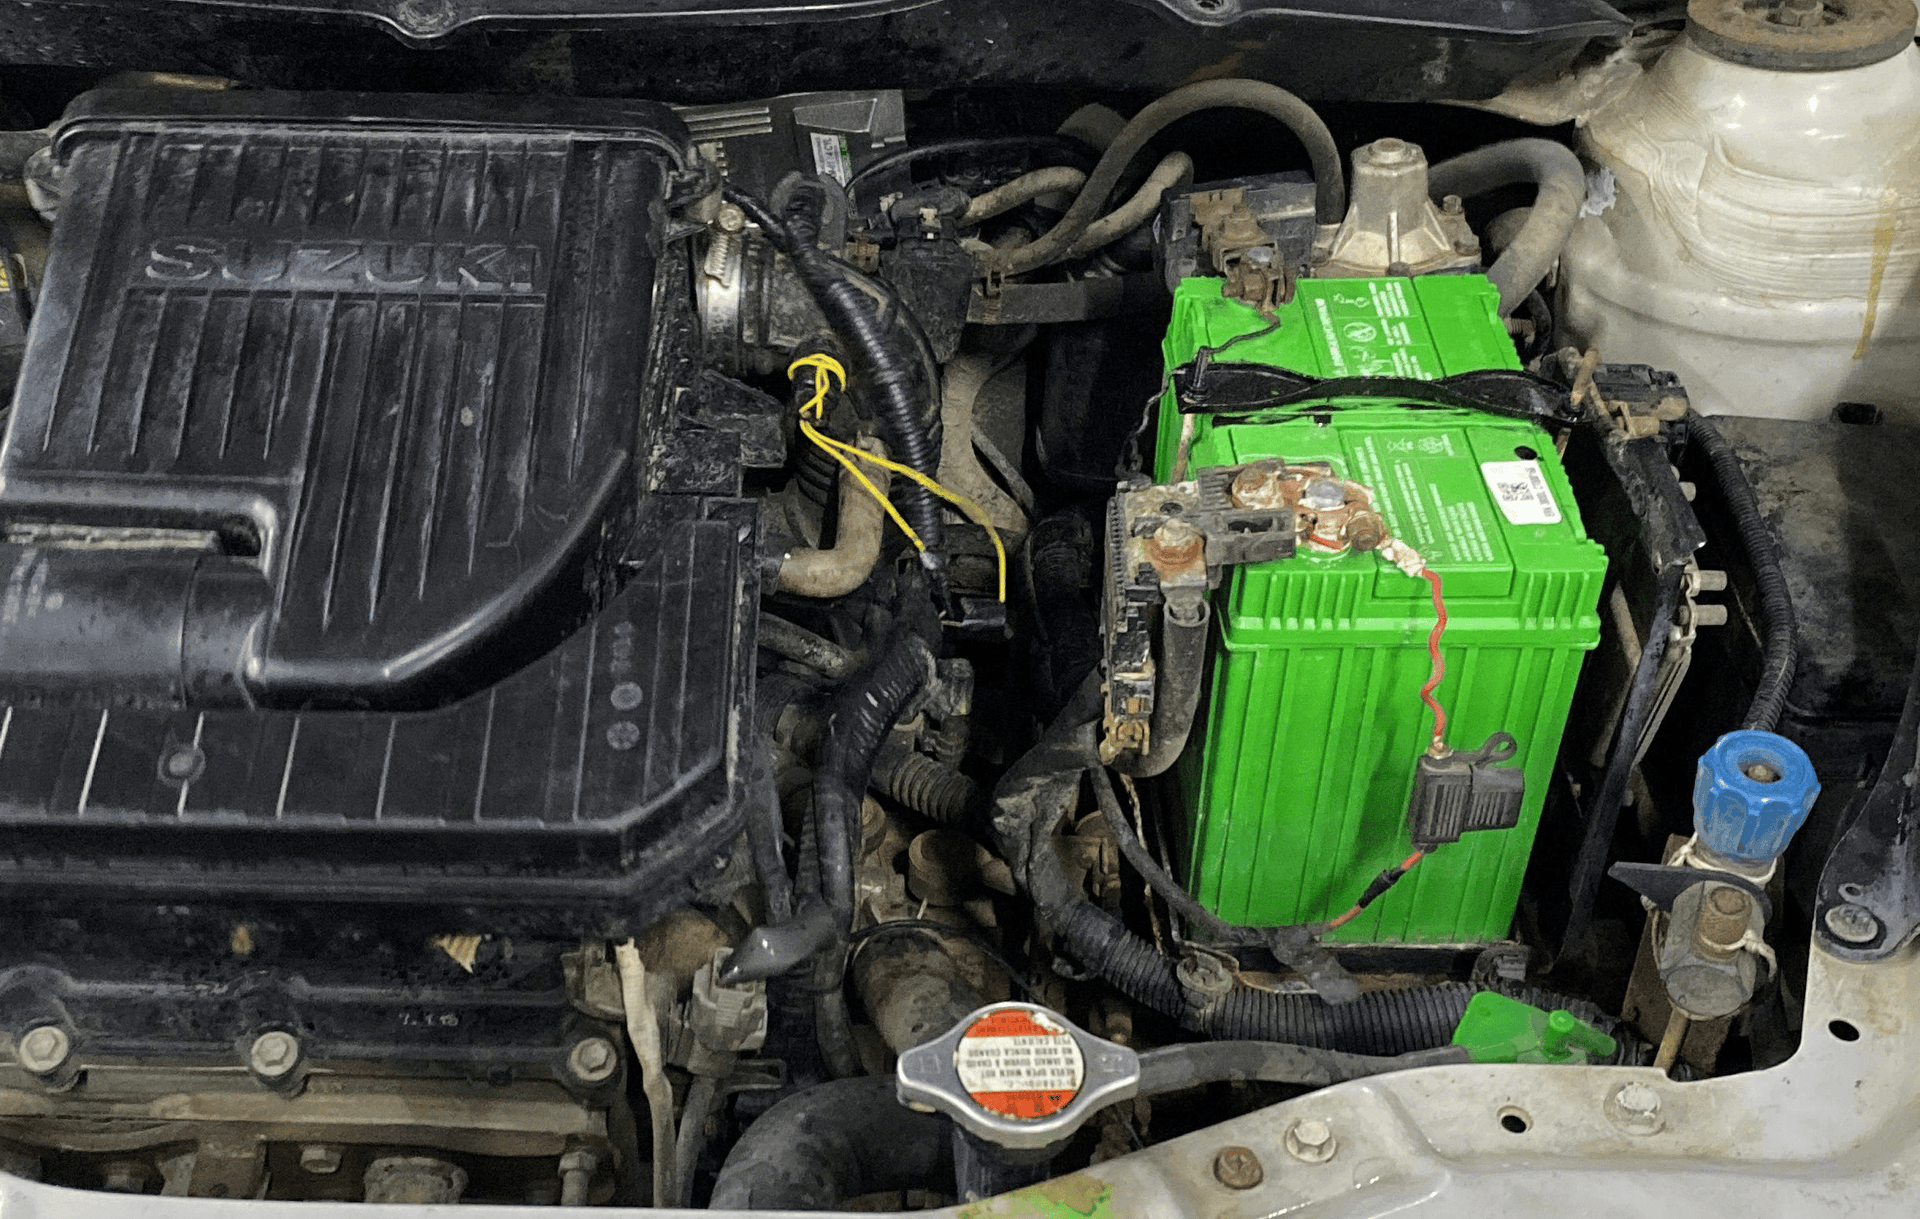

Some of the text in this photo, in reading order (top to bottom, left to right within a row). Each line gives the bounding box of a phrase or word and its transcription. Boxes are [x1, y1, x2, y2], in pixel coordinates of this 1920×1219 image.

[145, 237, 540, 291] SUZUKI
[1004, 1048, 1031, 1056] NUNCA
[1034, 1057, 1061, 1066] JAMAIS
[1000, 1069, 1022, 1077] WHEN
[1026, 1069, 1046, 1077] OPEN
